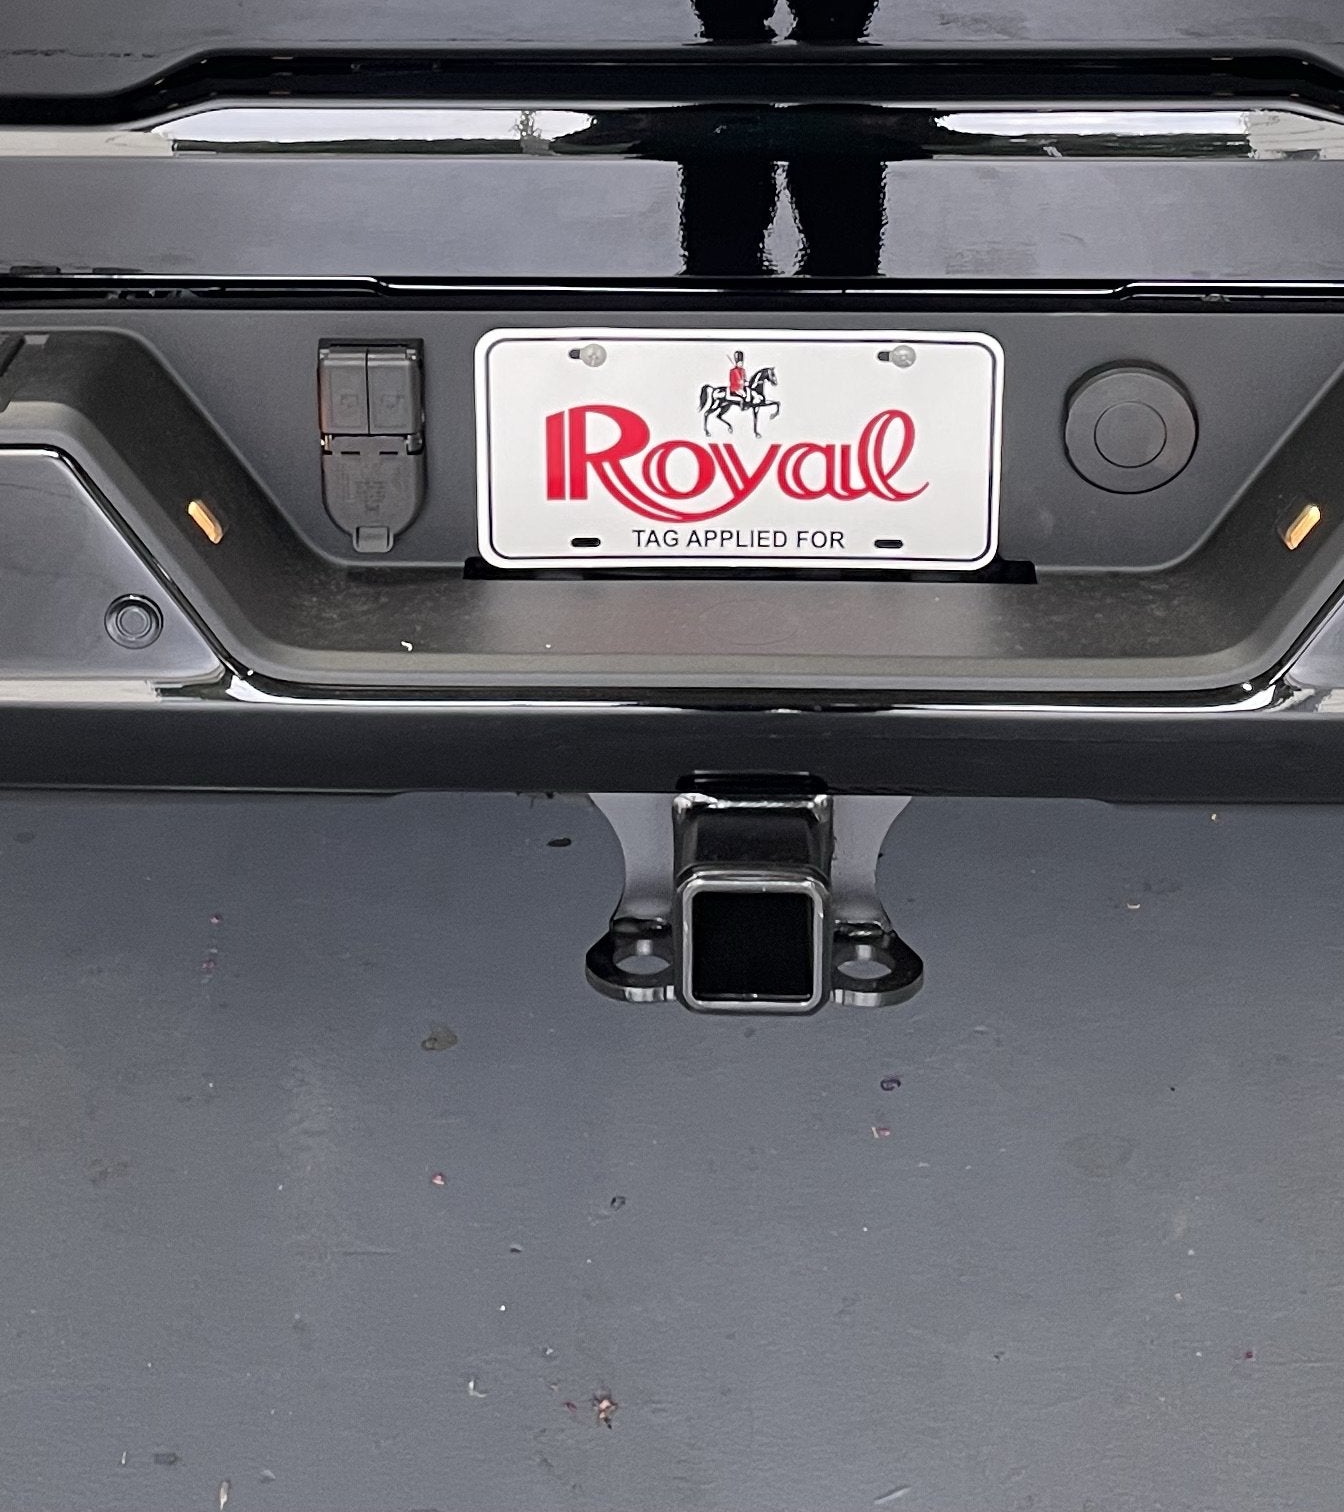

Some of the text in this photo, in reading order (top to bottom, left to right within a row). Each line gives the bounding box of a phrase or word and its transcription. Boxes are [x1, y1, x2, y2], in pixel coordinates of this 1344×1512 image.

[544, 403, 930, 524] Royal
[631, 529, 846, 550] TAG APPLIED FOR
